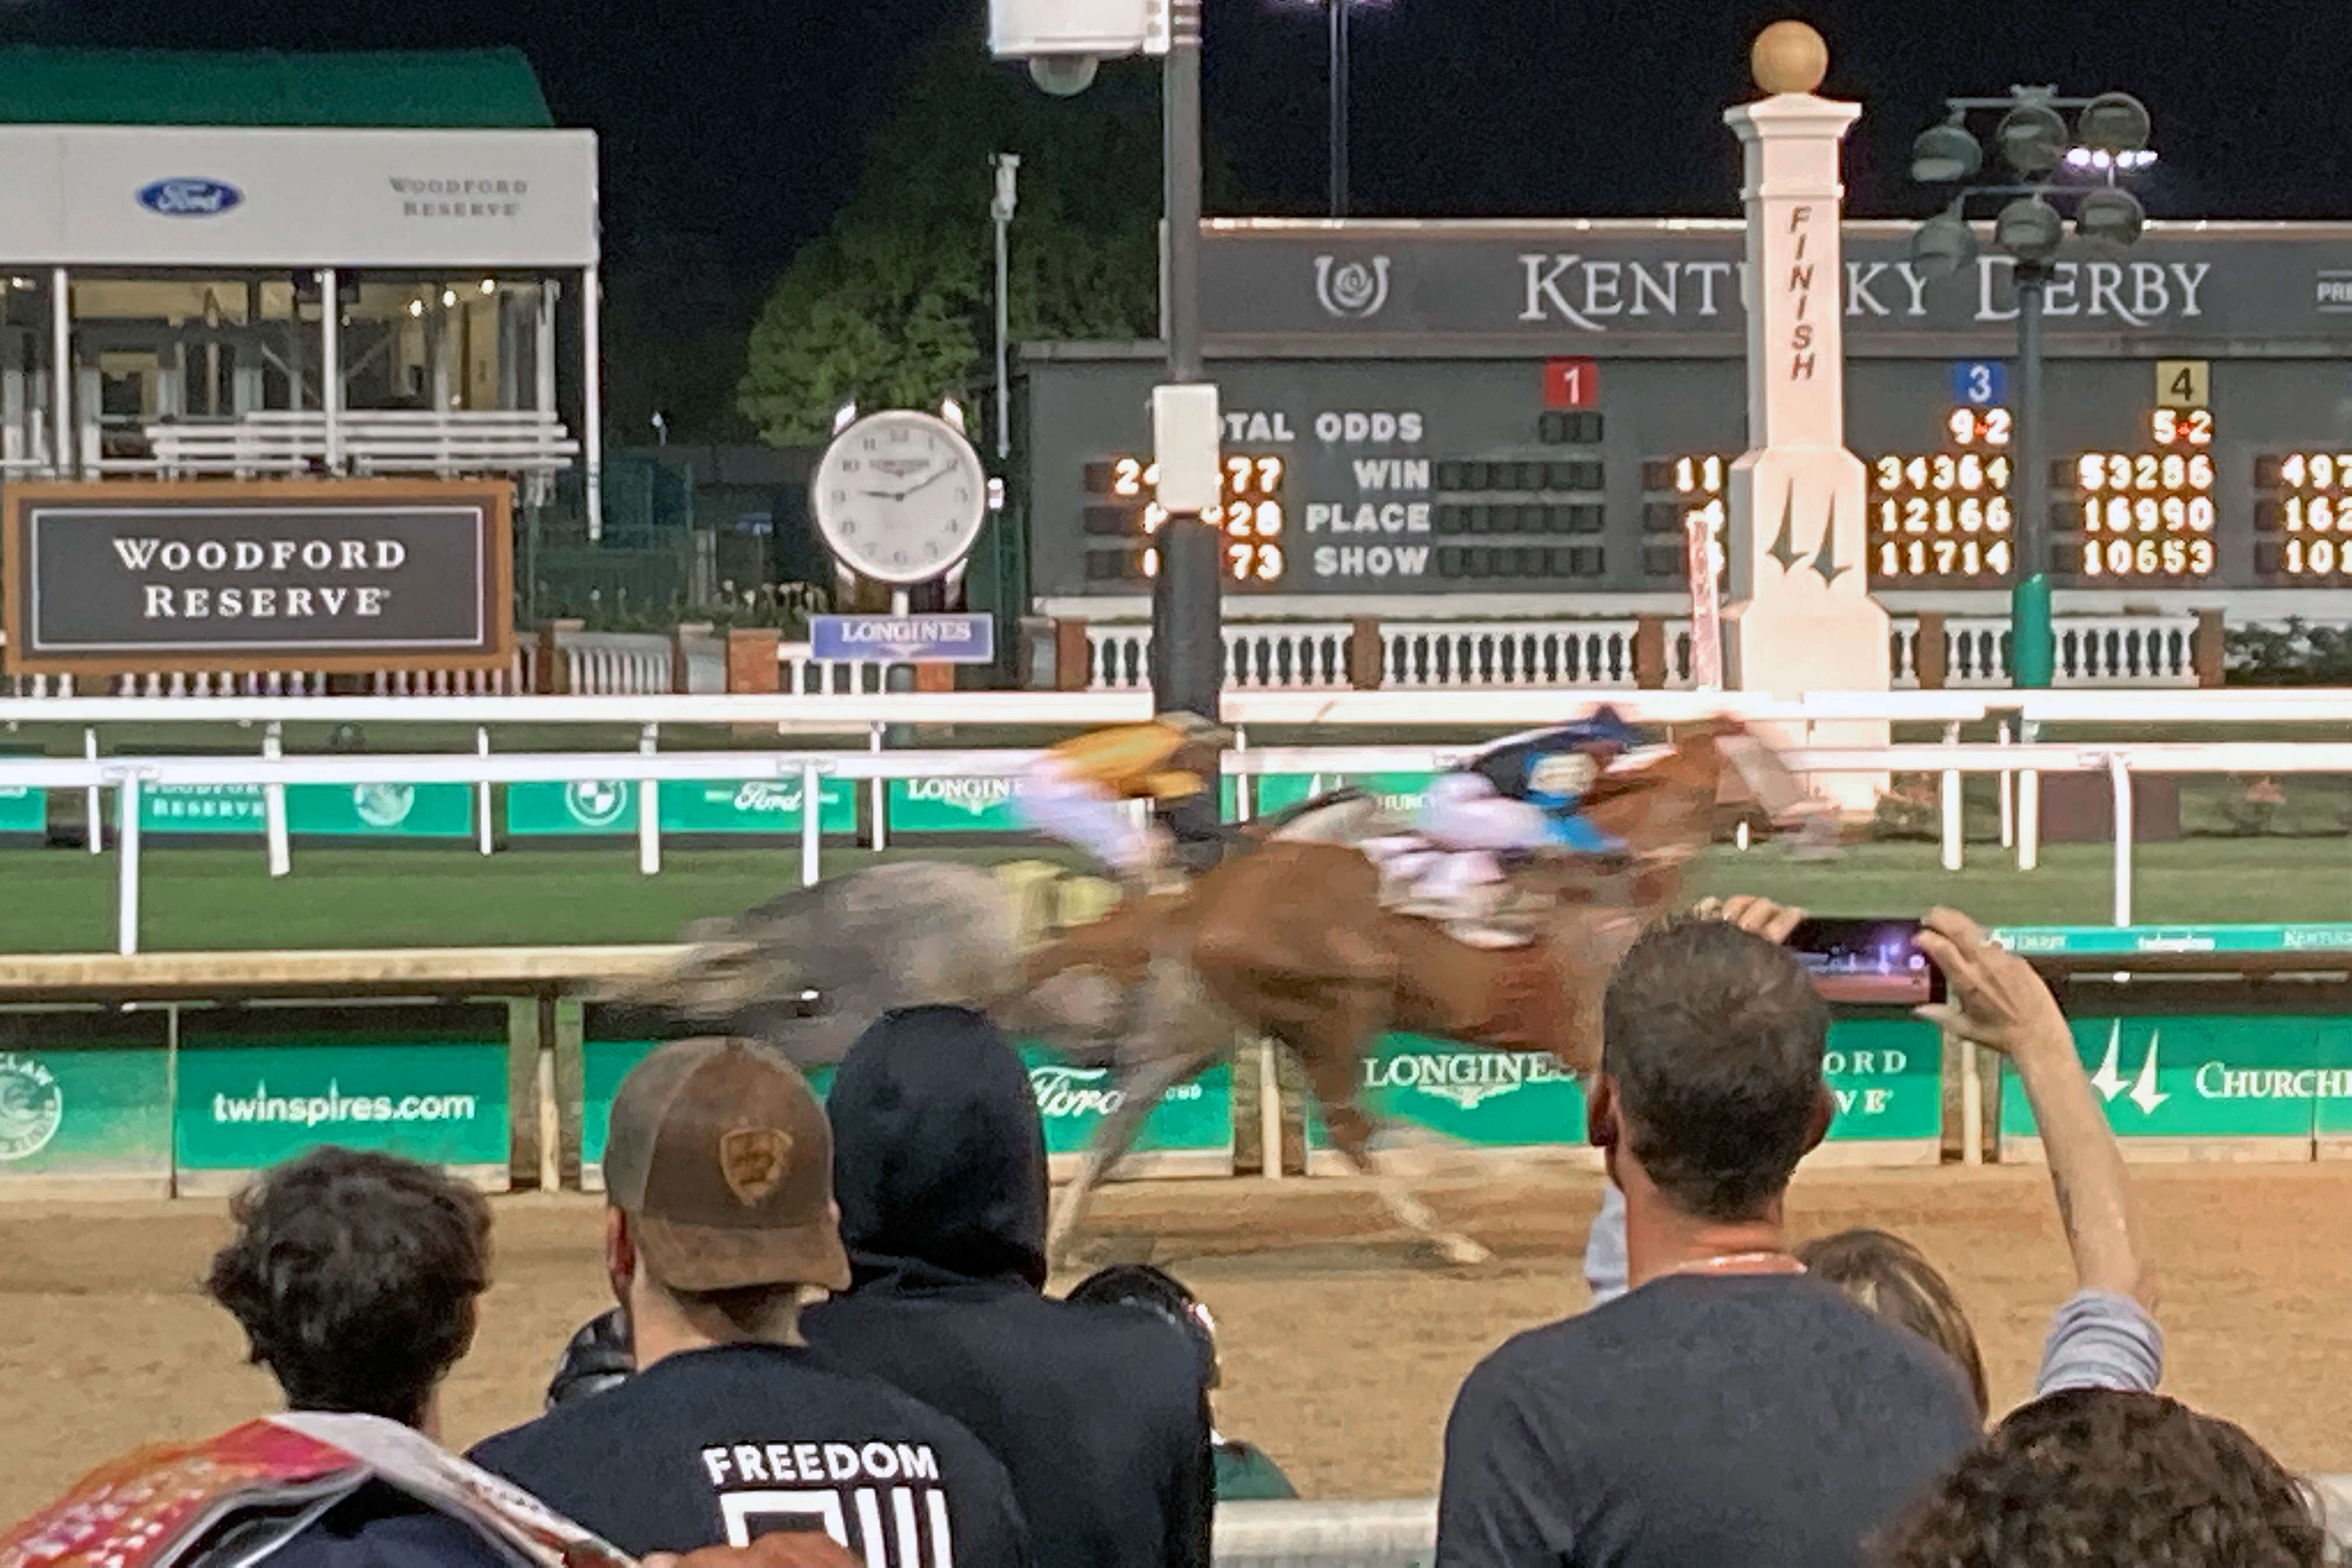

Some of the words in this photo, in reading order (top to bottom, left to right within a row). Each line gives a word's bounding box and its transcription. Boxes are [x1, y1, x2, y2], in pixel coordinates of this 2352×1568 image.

[388, 177, 528, 194] WOODFORD
[404, 202, 517, 216] RESERVE
[1518, 254, 1927, 330] KENTKY
[1974, 255, 2211, 327] DERBY
[1788, 206, 1814, 380] FINISH
[1564, 368, 1580, 405] 1
[1968, 364, 1992, 402] 3
[2171, 366, 2193, 401] 4
[1315, 412, 1423, 442] ODDS
[2153, 410, 2211, 444] 5-2
[1353, 459, 1430, 489] WIN
[1306, 503, 1432, 532] PLACE
[113, 539, 406, 570] WOODFORD
[1313, 545, 1430, 576] SHOW
[842, 620, 971, 642] LONGINES
[212, 1077, 475, 1128] twinspires.com
[702, 1442, 939, 1485] FREEDOM
